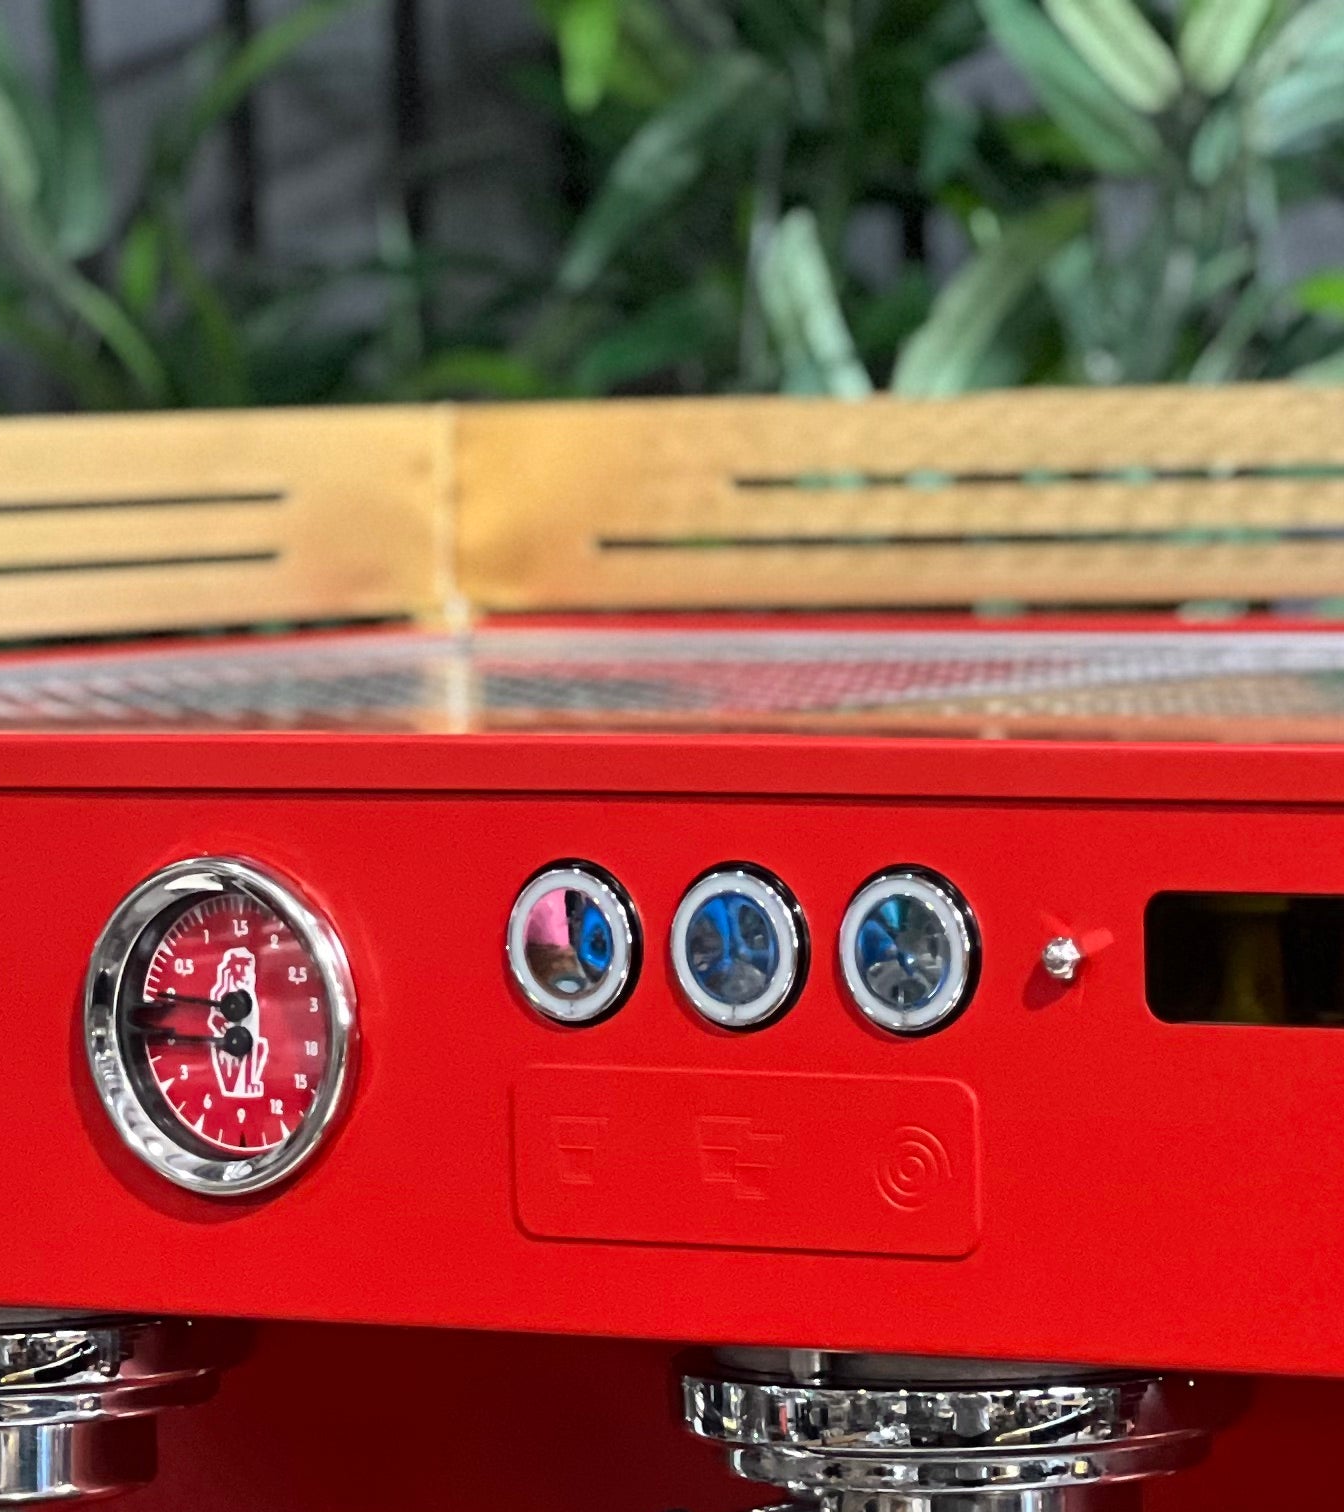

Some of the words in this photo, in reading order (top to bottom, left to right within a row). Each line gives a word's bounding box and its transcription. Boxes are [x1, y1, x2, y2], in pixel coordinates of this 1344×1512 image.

[203, 929, 210, 944] 1
[270, 933, 280, 949] 2
[309, 997, 319, 1013] 3
[179, 1064, 189, 1080] 3
[294, 1073, 308, 1089] 15
[202, 1094, 213, 1109] 6
[269, 1099, 284, 1116] 12
[236, 1107, 247, 1124] 9
